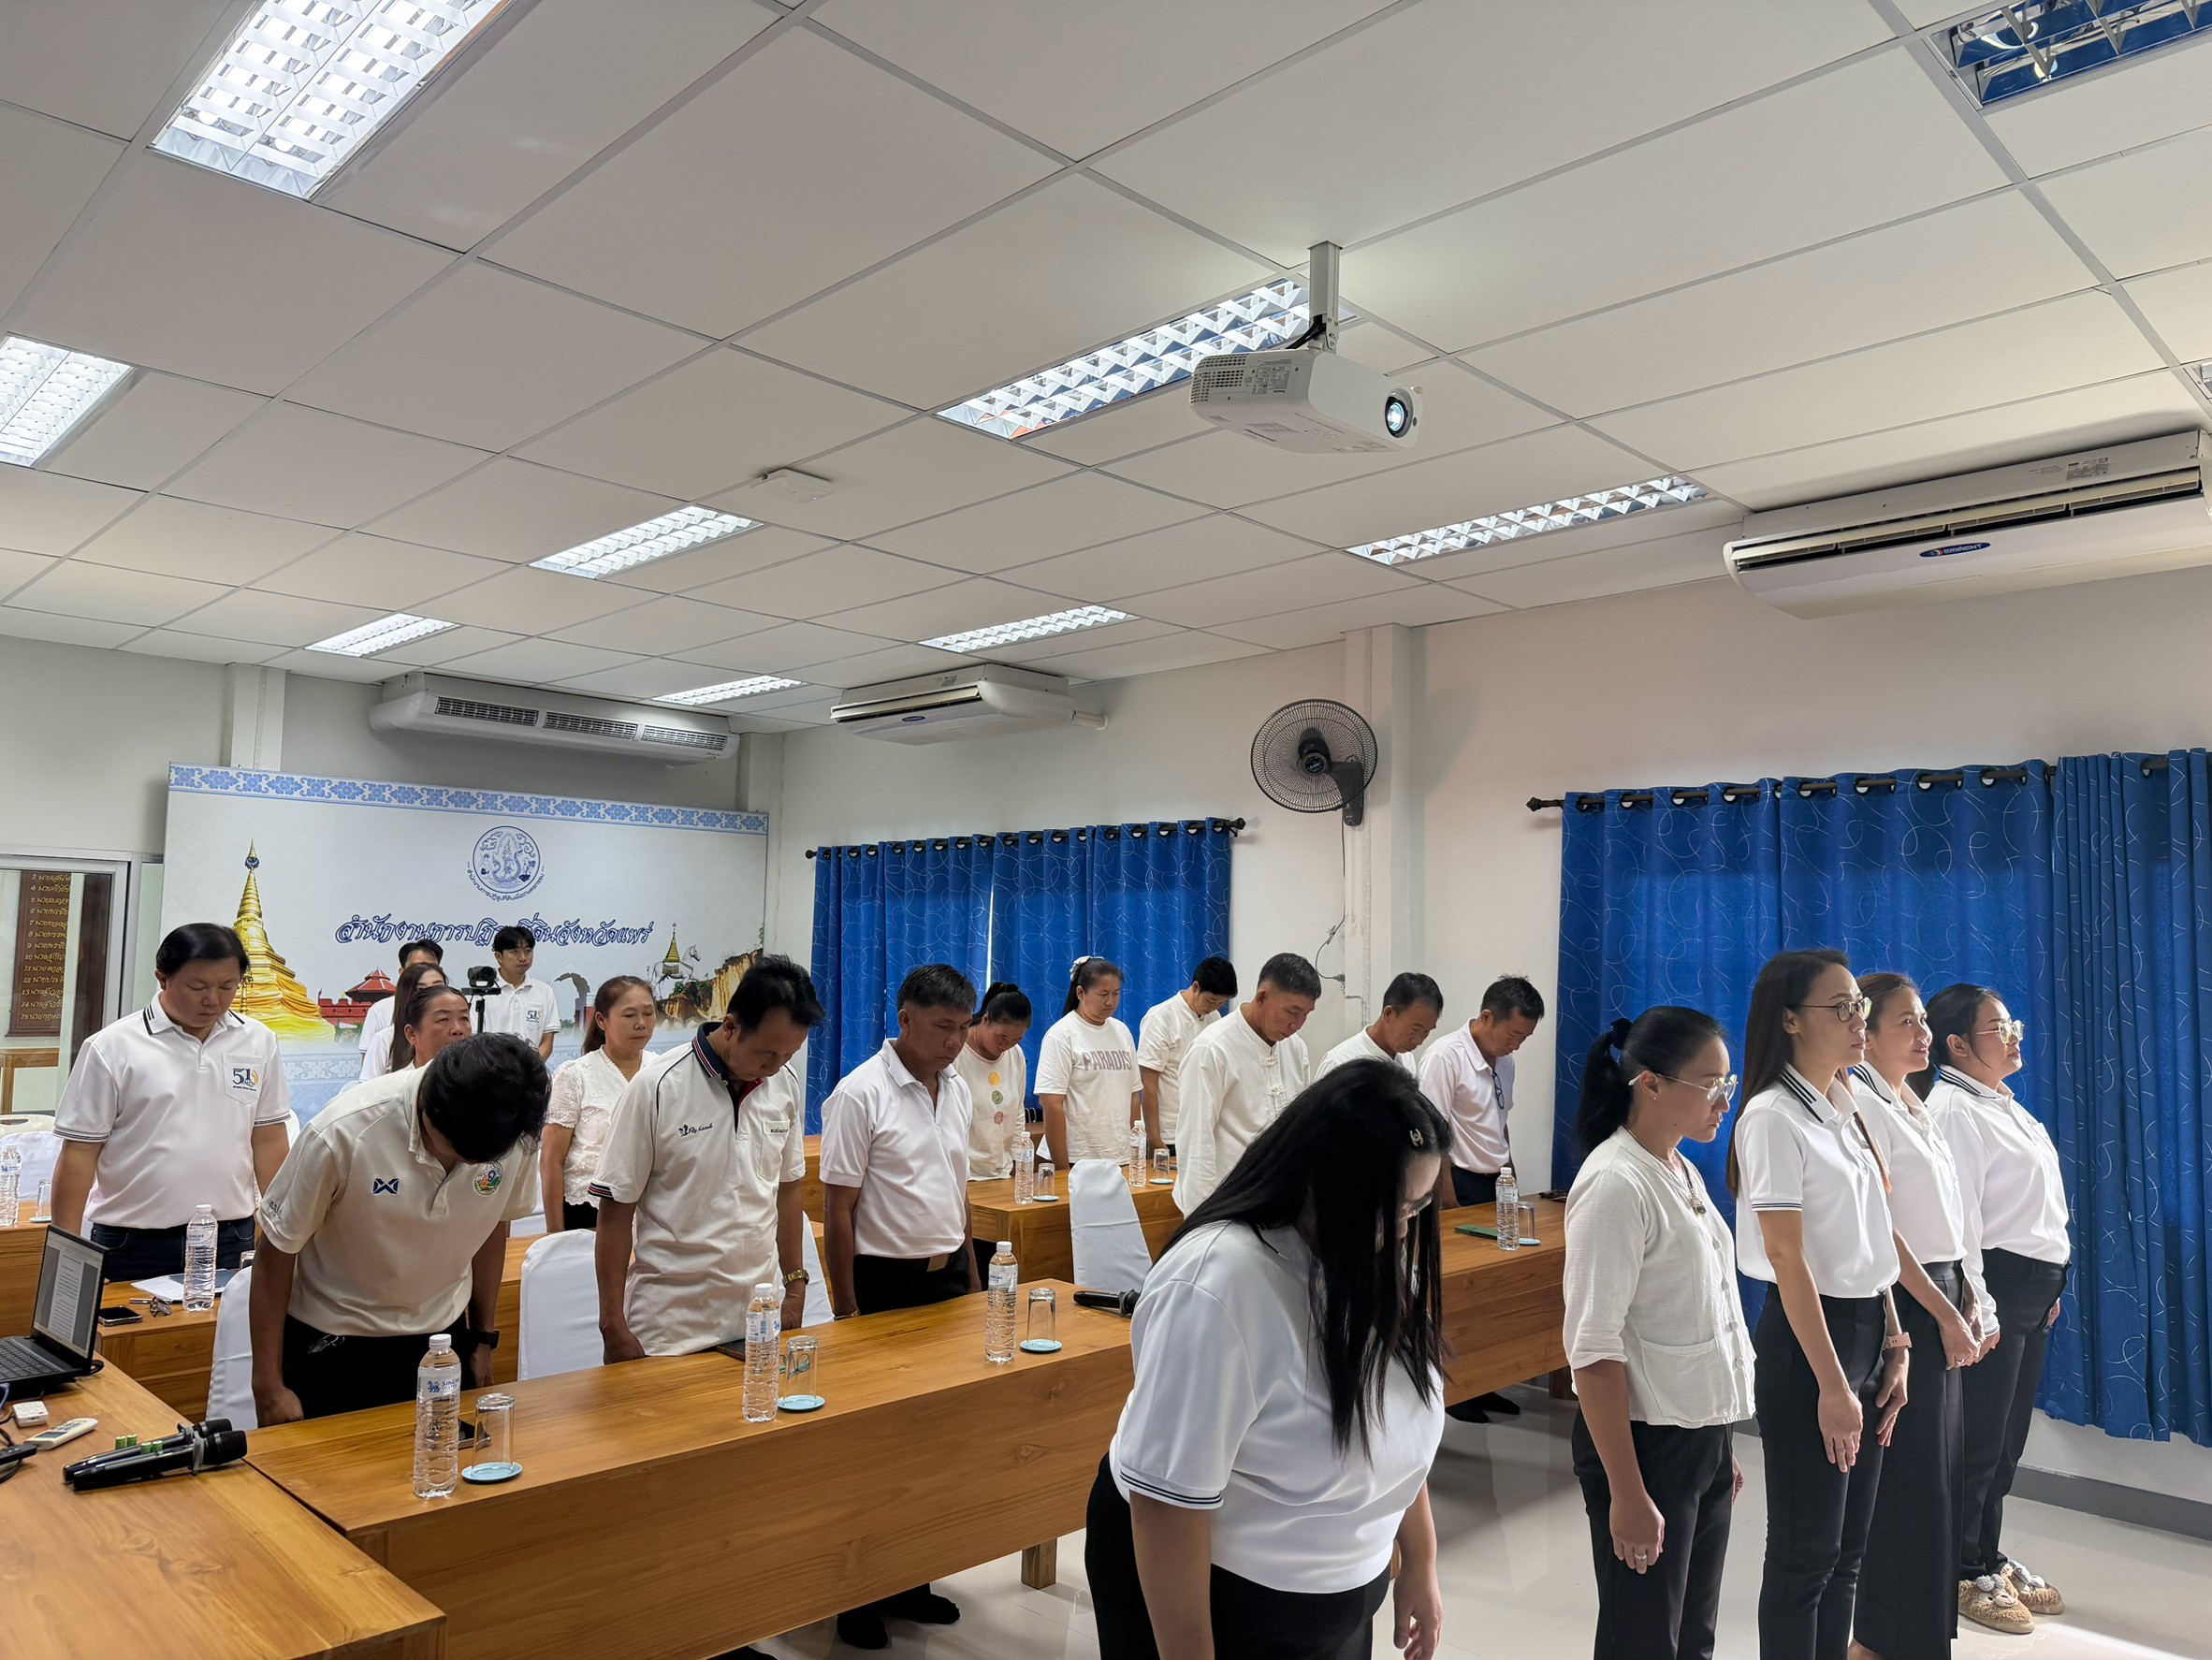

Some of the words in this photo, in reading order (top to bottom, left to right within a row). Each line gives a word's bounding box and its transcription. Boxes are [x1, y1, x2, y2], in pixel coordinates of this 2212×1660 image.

[335, 912, 654, 947] สำนักงานการปฏิี่ดินจังหวัดแพร่
[232, 1068, 251, 1085] 51
